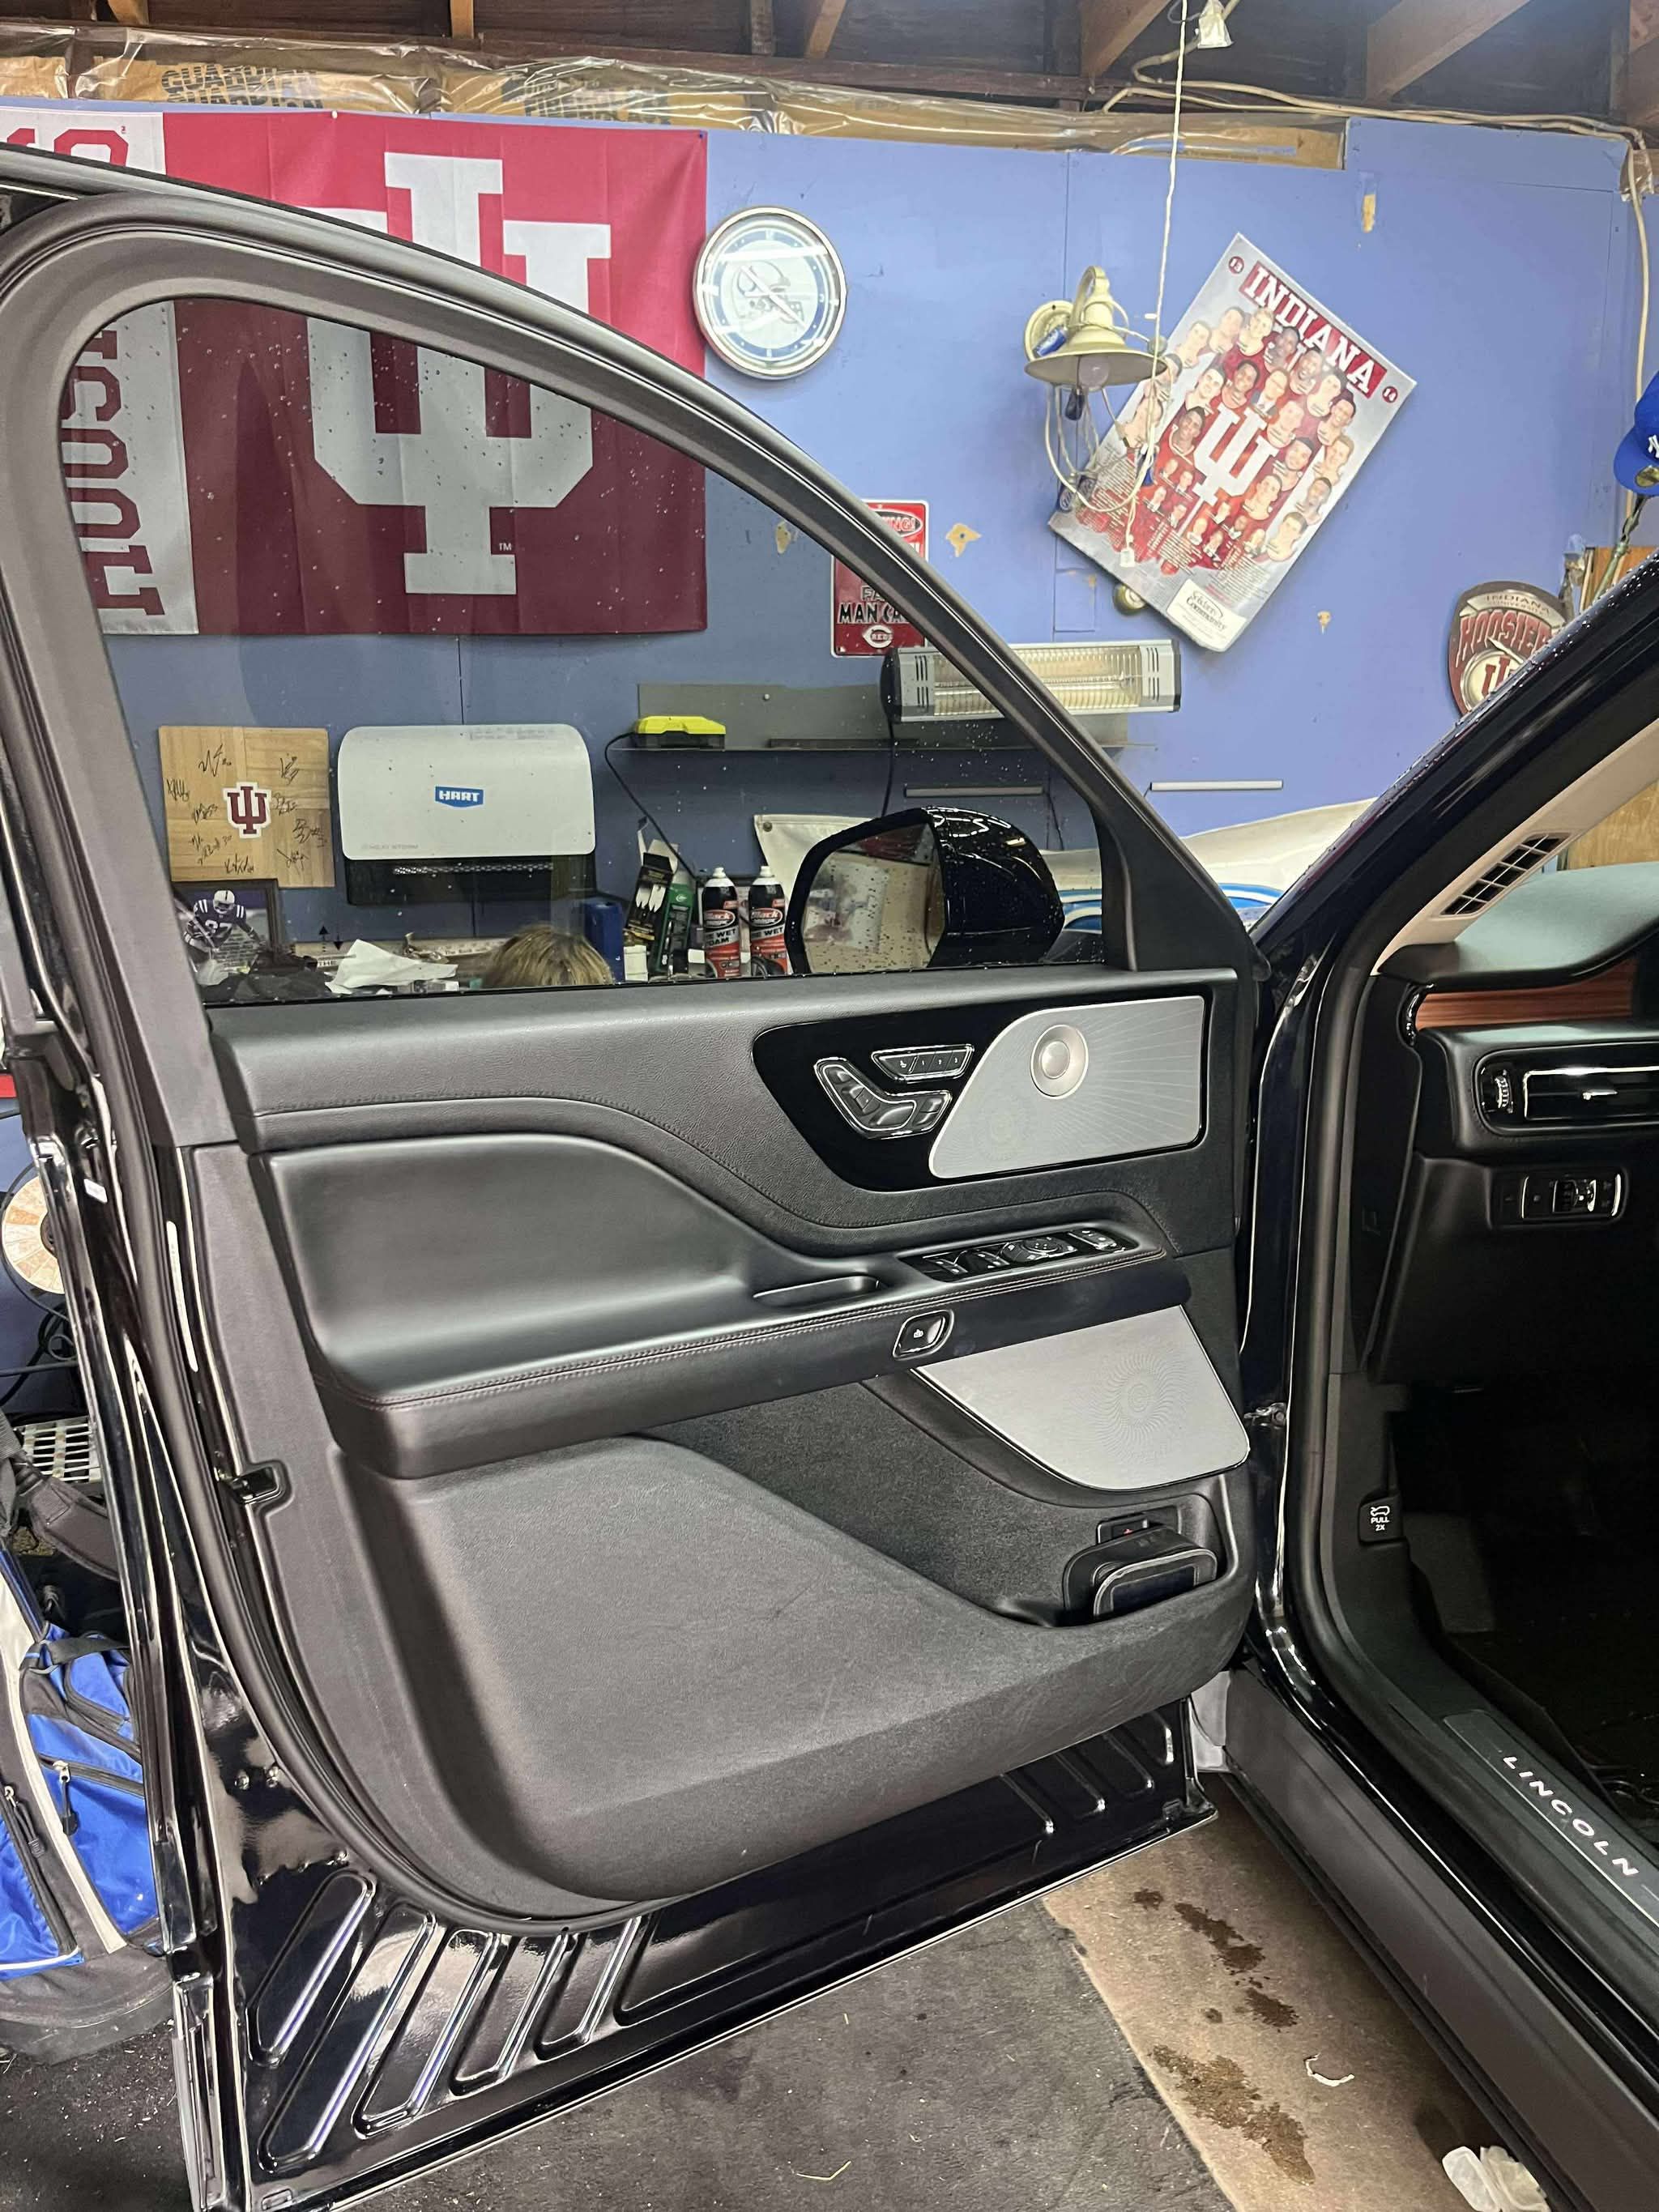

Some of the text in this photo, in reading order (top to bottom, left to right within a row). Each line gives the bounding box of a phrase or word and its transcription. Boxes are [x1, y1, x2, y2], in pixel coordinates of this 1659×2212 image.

[1244, 266, 1376, 394] INDIANA
[498, 542, 512, 551] TM
[1486, 595, 1550, 614] INDIANA
[838, 602, 910, 624] MAN CA
[438, 790, 480, 803] HART
[716, 928, 736, 938] WET
[704, 937, 730, 947] OAM
[1370, 1516, 1390, 1524] PULL
[1375, 1524, 1386, 1532] 2X
[1503, 1756, 1640, 1876] LINCOLN
